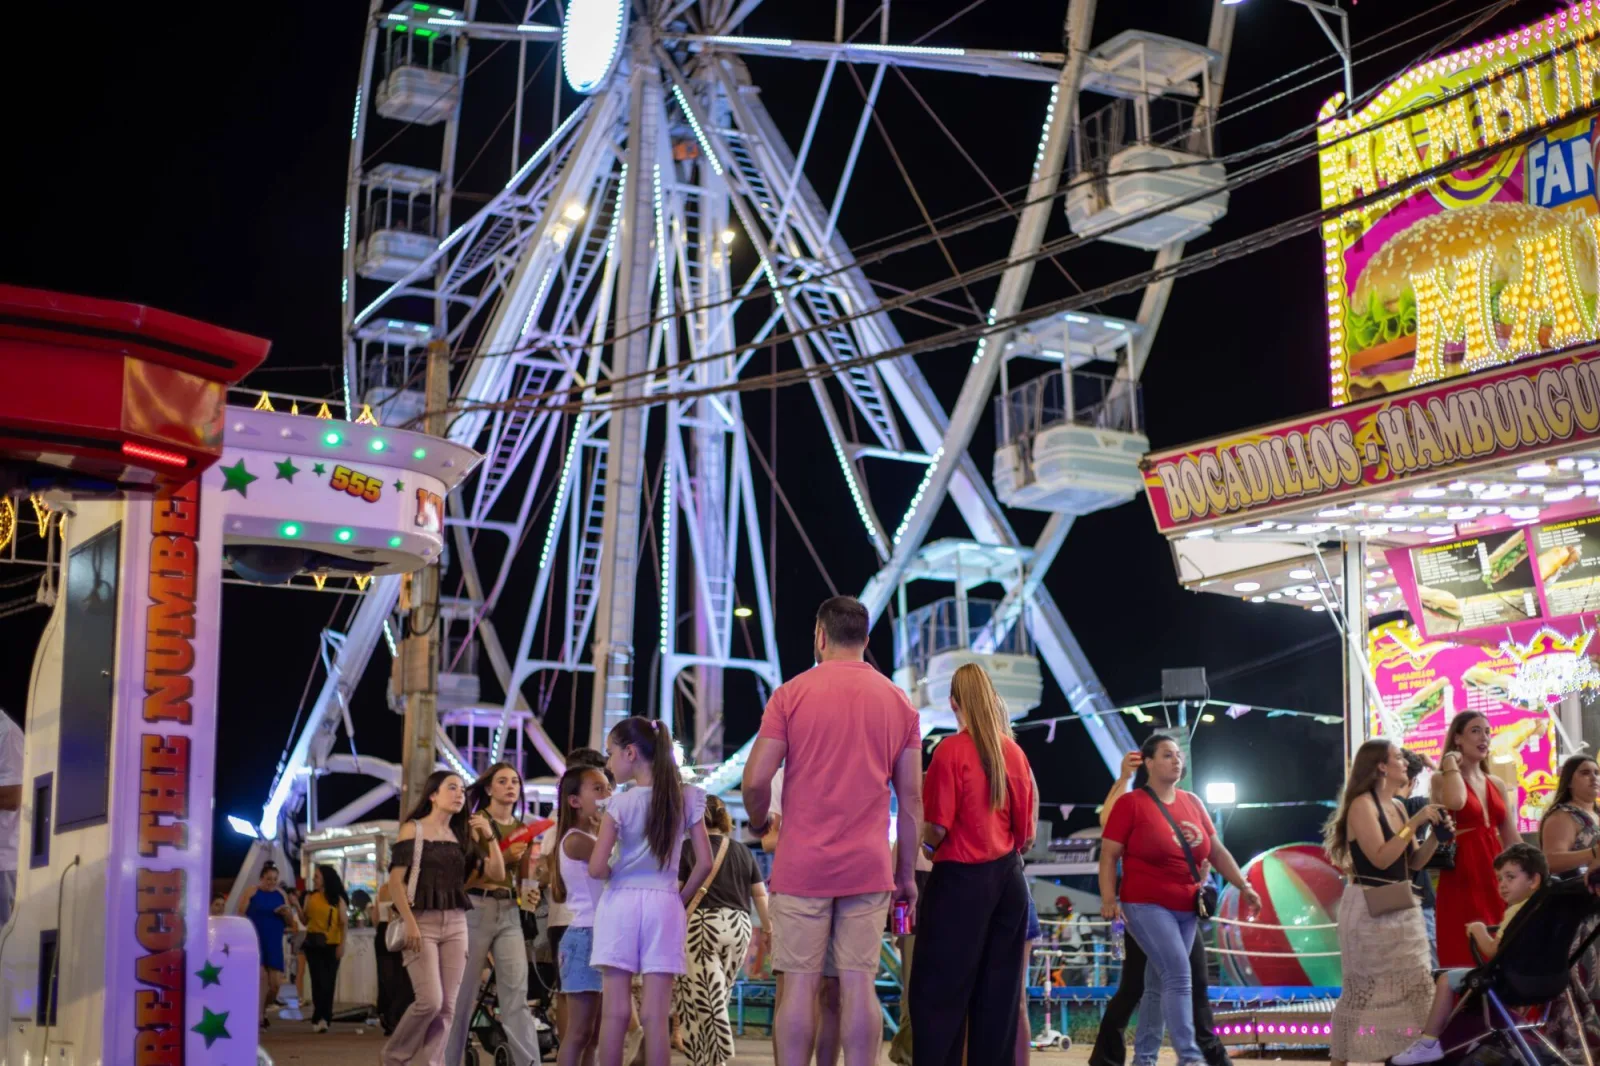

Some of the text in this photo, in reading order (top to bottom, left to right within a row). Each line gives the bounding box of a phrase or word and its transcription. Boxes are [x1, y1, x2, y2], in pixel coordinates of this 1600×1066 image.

[1409, 217, 1600, 385] MA
[329, 463, 383, 503] 555
[1158, 418, 1362, 523] BOCADILLOS
[1377, 358, 1600, 474] HAMBURGU
[138, 733, 191, 857] THE
[134, 867, 189, 1066] REACH
